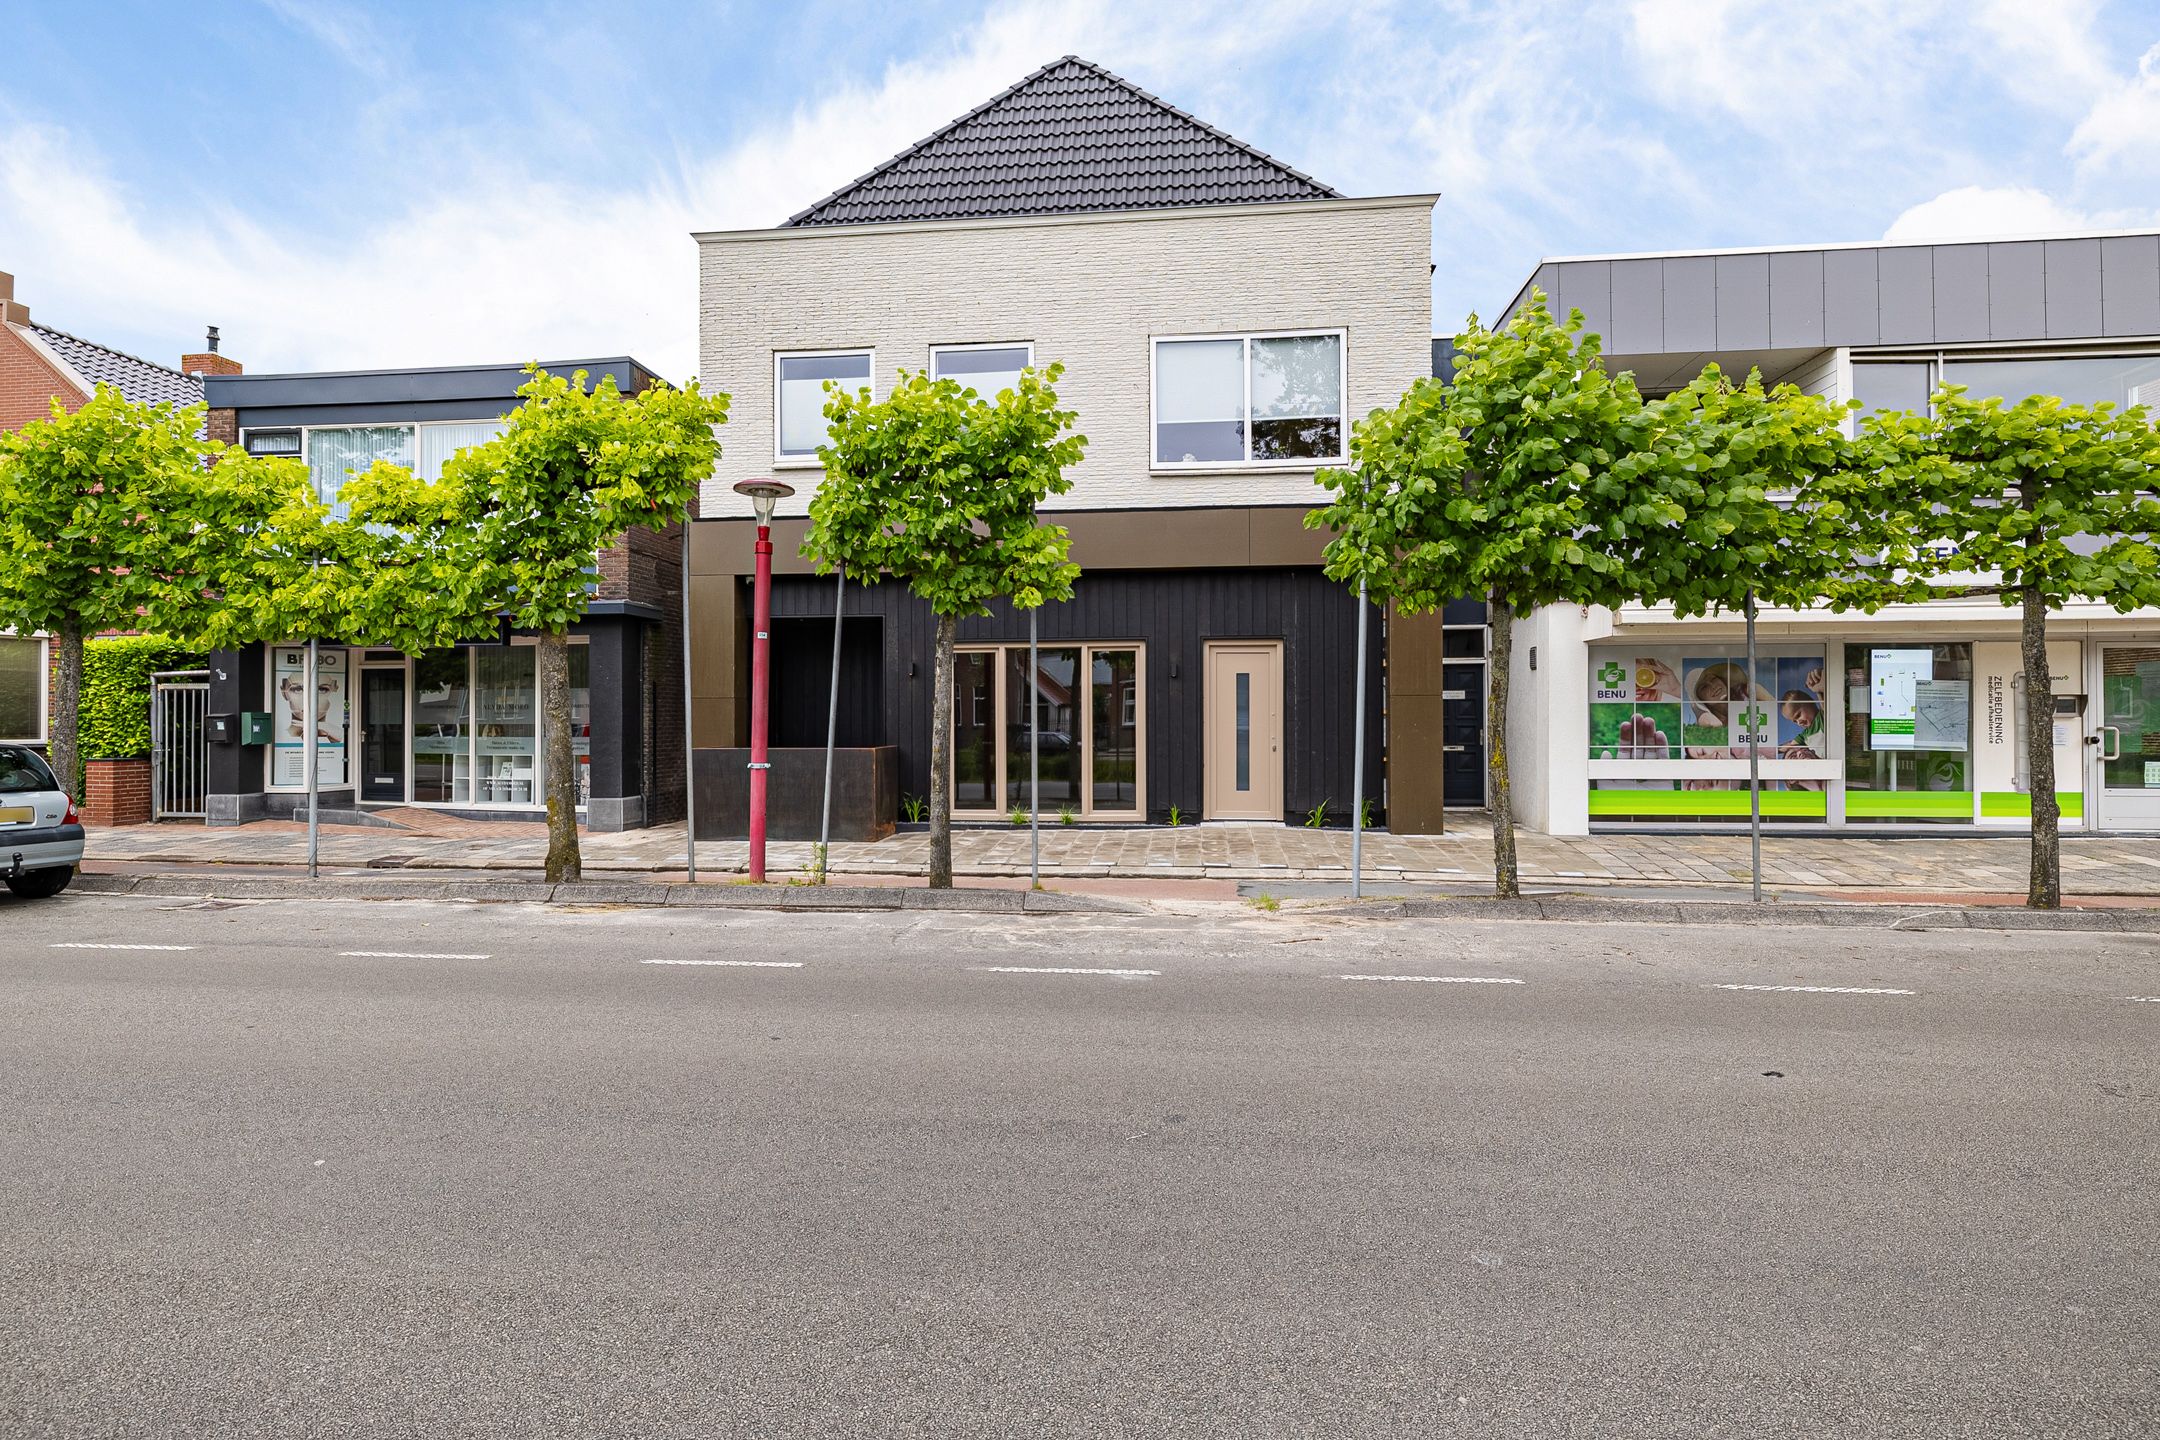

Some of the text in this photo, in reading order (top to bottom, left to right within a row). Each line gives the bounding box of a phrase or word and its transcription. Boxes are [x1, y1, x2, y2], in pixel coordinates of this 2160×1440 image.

[1597, 690, 1627, 699] BENU
[1994, 676, 2003, 744] ZELFBEDIENING
[1738, 734, 1768, 743] BEU
